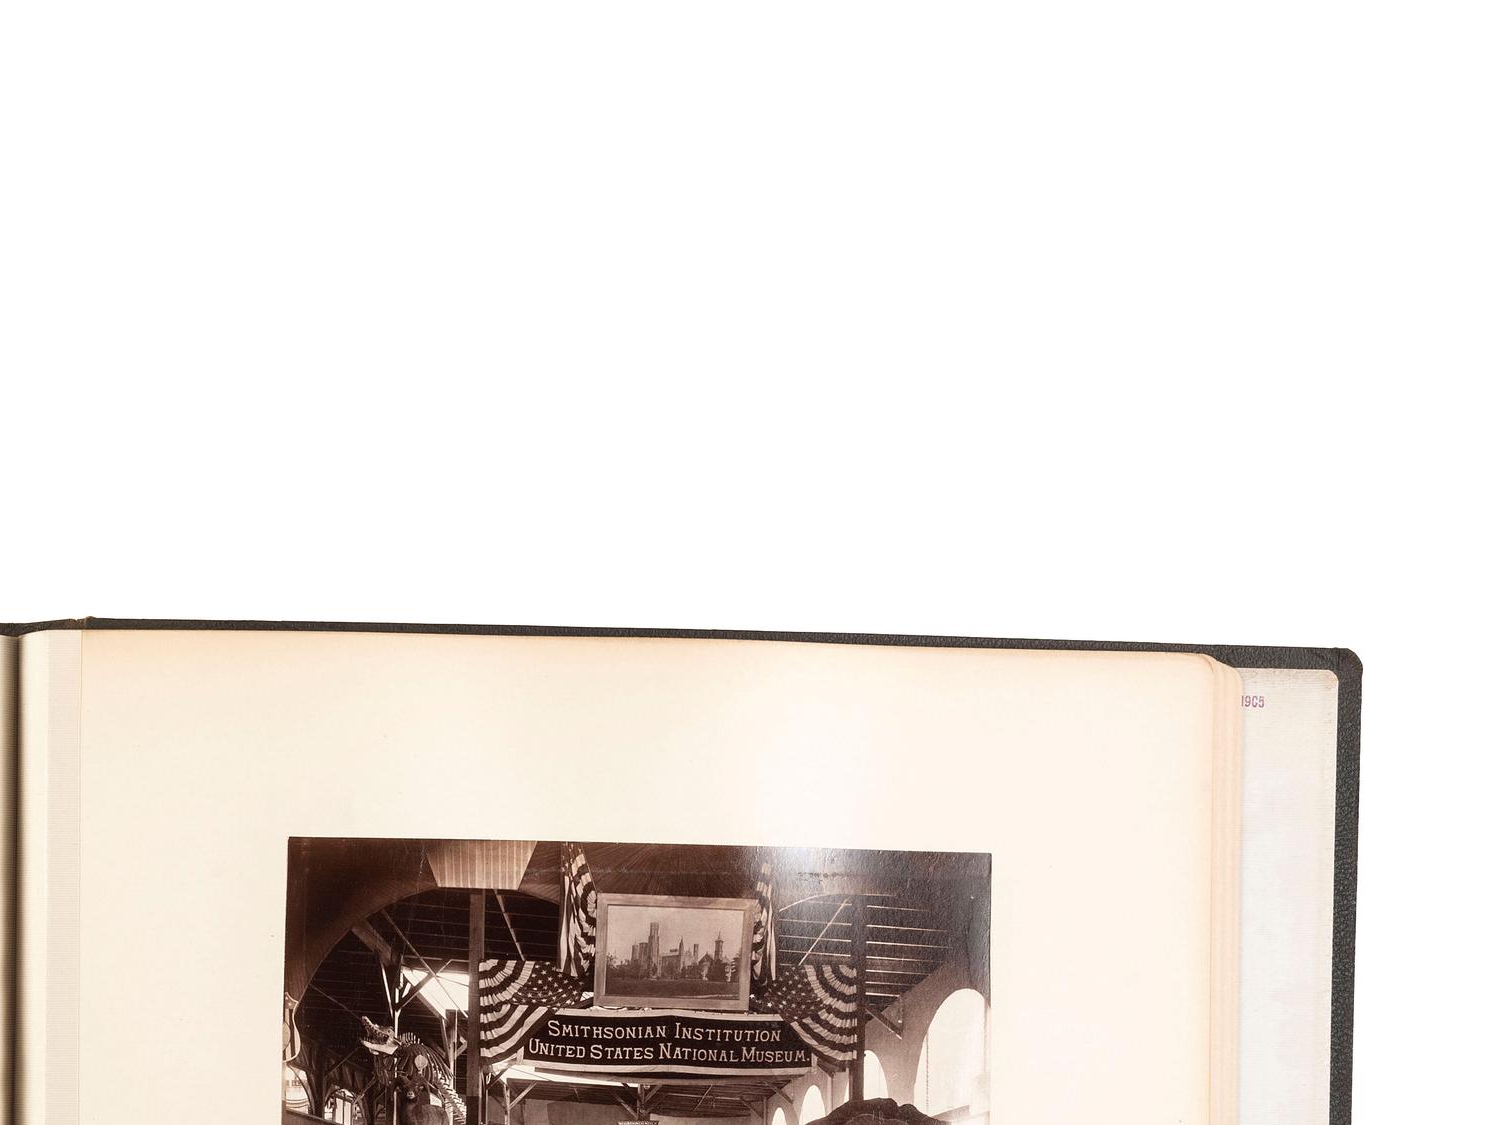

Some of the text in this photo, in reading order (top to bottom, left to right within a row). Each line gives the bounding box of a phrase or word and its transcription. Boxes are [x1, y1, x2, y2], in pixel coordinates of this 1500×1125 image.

[547, 1020, 781, 1042] SMITHSONIAN INSTITUTION
[528, 1038, 810, 1063] UNITED STATES NATIONAL MUSEUM.
